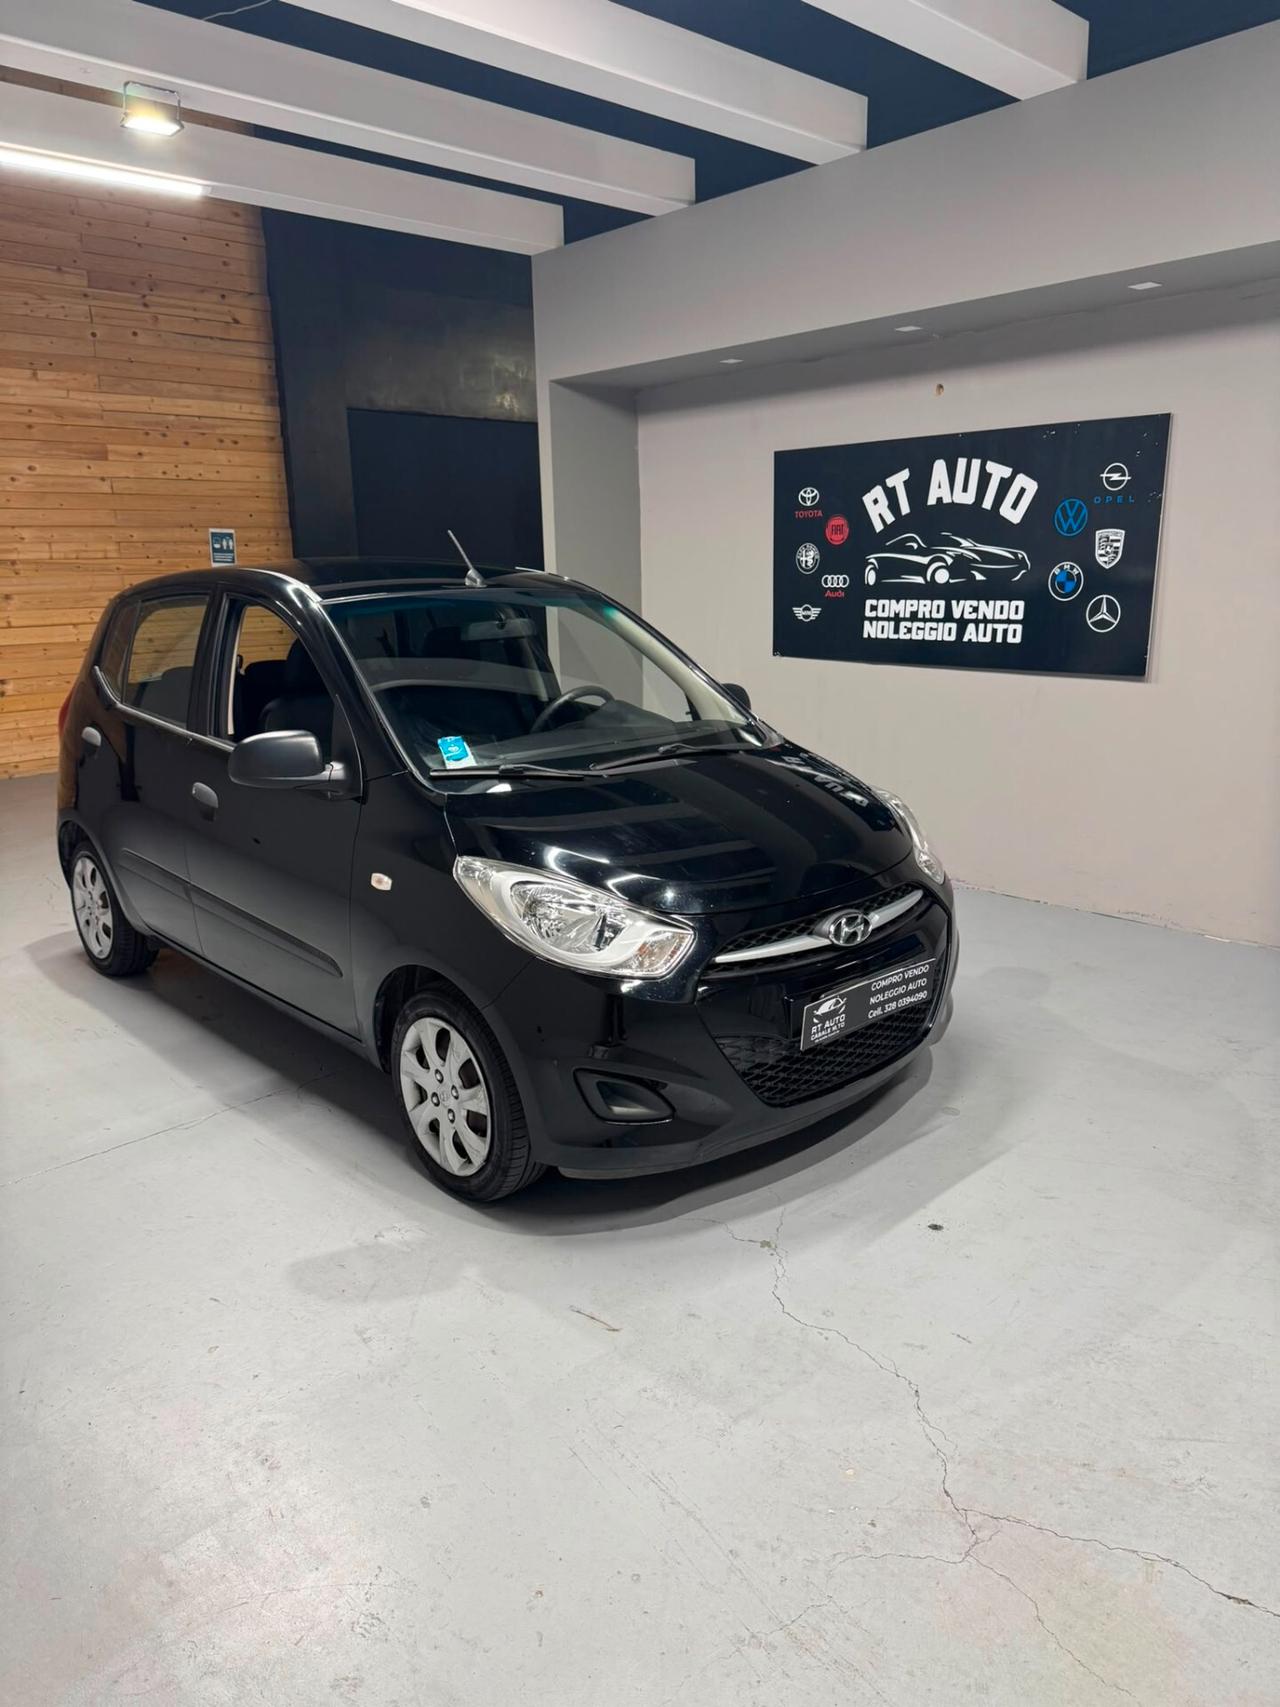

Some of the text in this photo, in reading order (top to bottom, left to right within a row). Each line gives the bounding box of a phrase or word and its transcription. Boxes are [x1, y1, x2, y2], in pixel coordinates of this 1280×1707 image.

[862, 457, 1039, 533] RT AUTO
[1093, 495, 1135, 504] OPEL
[794, 510, 823, 519] TOYOTA
[824, 590, 845, 598] Audi
[864, 599, 1025, 621] COMPRO VENDO
[862, 620, 1023, 644] NOLEGGIO AUTO
[871, 964, 930, 992] COMPRO VENDO
[869, 977, 928, 1006] NOLEGGIO AUTO
[811, 1013, 846, 1035] RT AUTO
